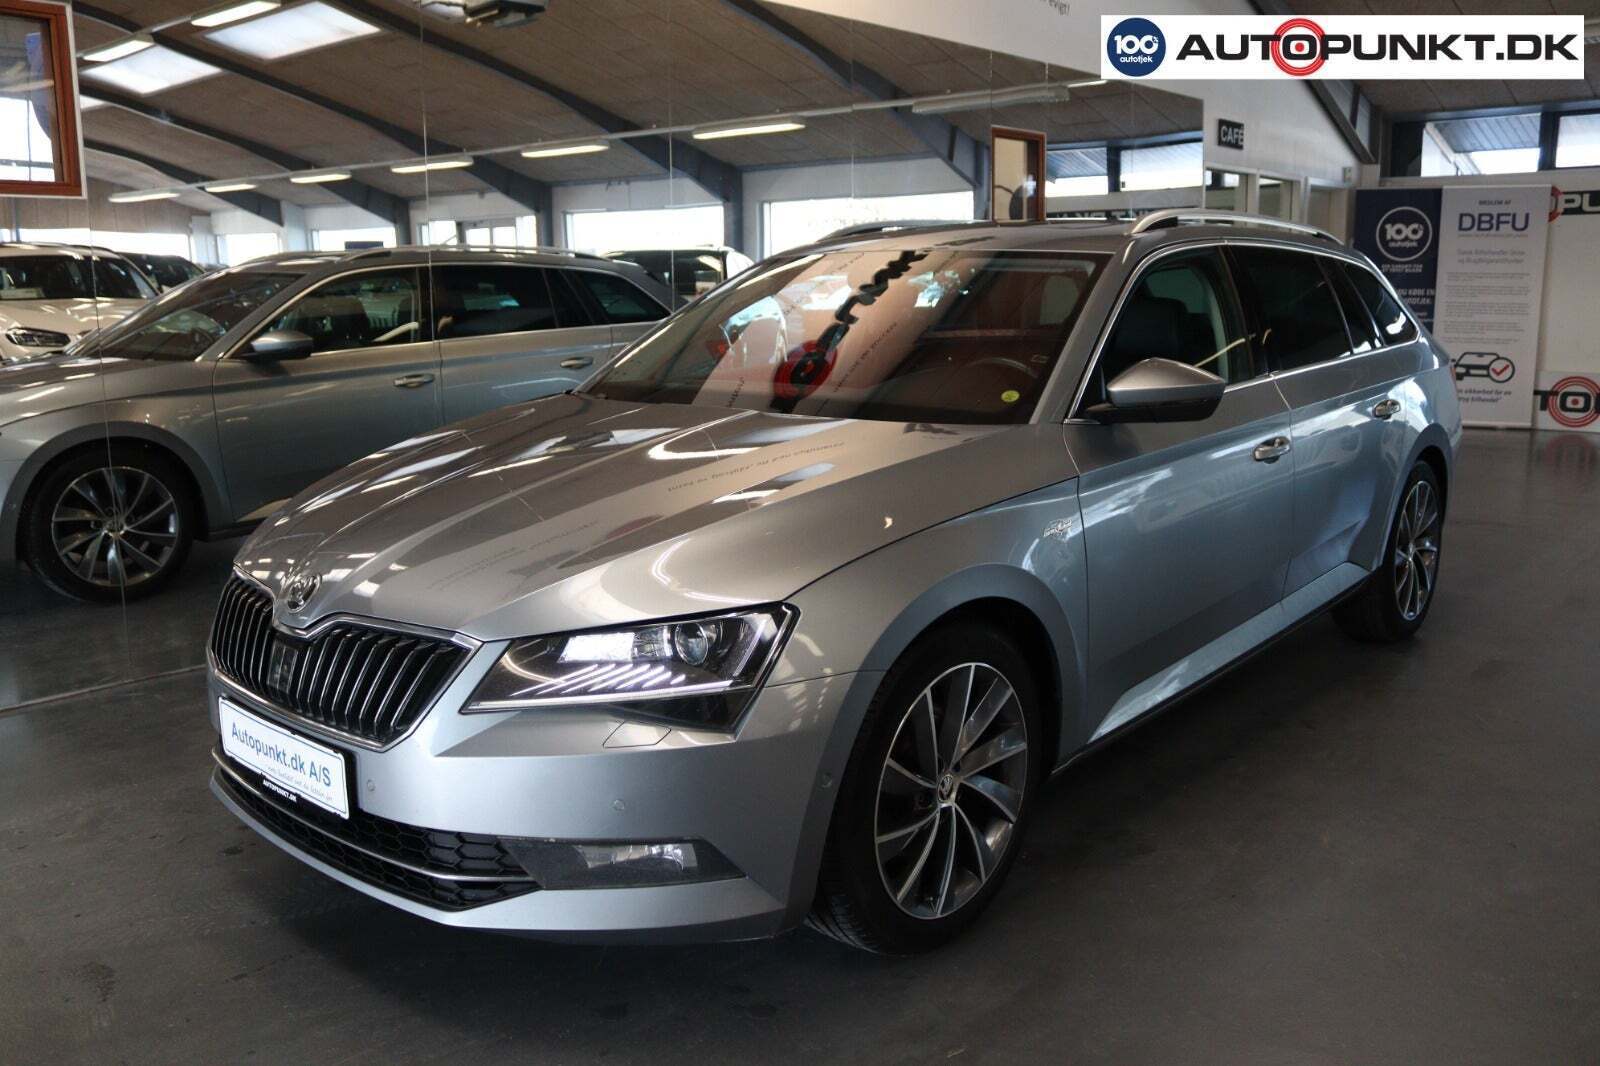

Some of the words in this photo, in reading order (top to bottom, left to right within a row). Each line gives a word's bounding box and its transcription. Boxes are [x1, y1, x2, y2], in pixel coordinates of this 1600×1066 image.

[1458, 212, 1530, 232] DBFU
[231, 721, 305, 775] Autopunkt.dk
[309, 760, 331, 787] A/S
